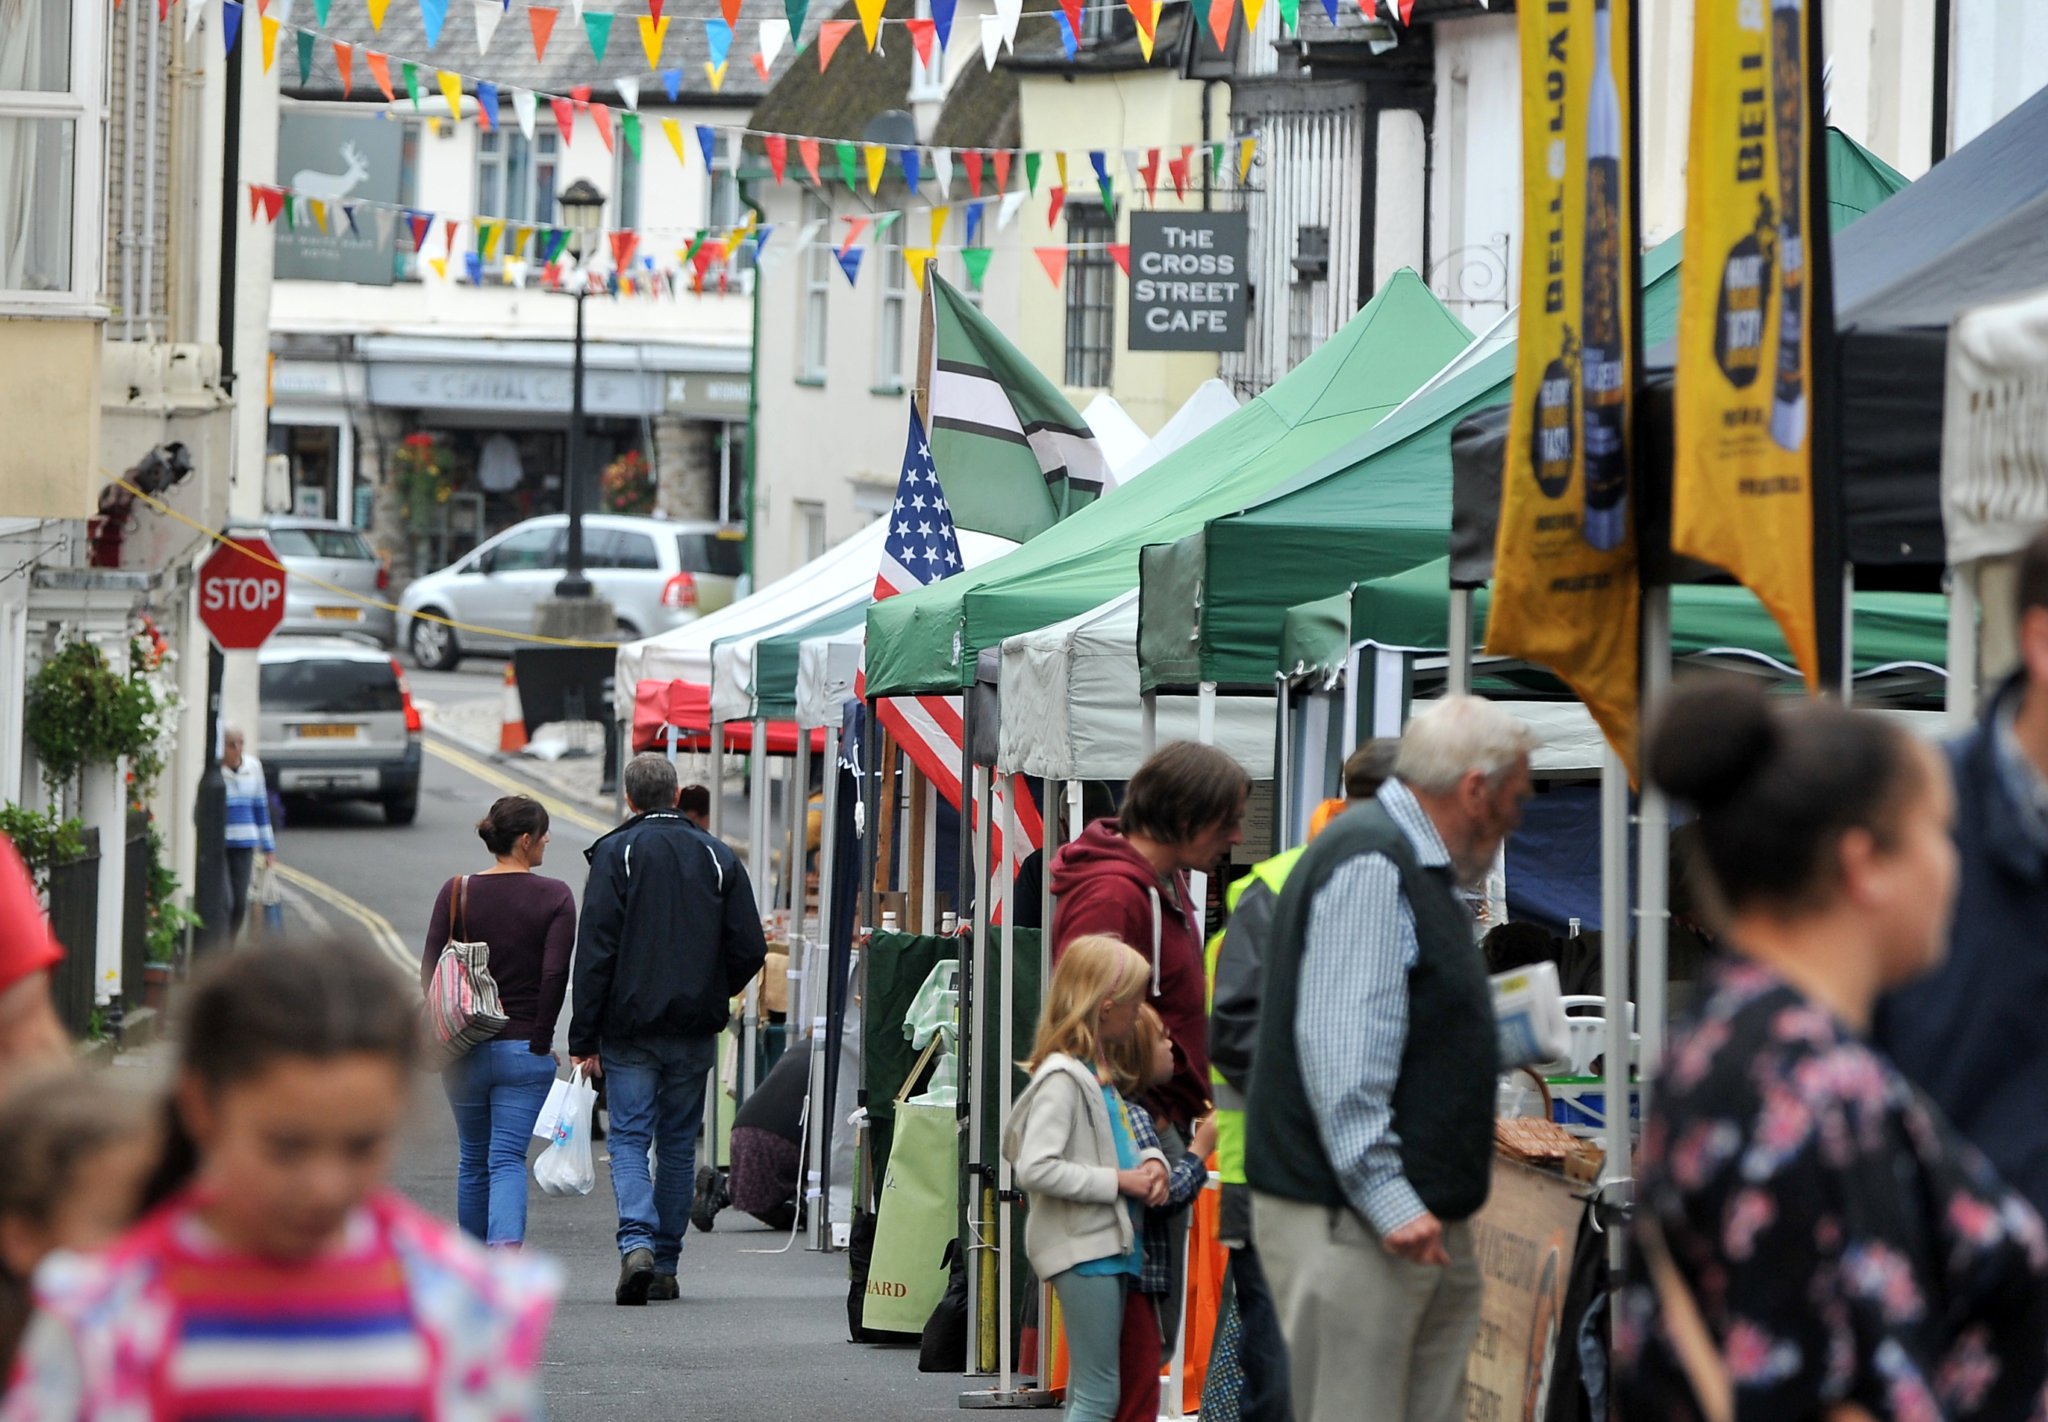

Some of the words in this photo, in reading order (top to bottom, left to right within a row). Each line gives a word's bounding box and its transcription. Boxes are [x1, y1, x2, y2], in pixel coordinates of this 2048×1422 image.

[1161, 226, 1214, 249] THE
[1545, 180, 1564, 313] BELL
[1139, 251, 1235, 275] CROSS
[1135, 279, 1240, 303] STREET
[1145, 306, 1228, 333] CAFE
[204, 577, 281, 611] STOP
